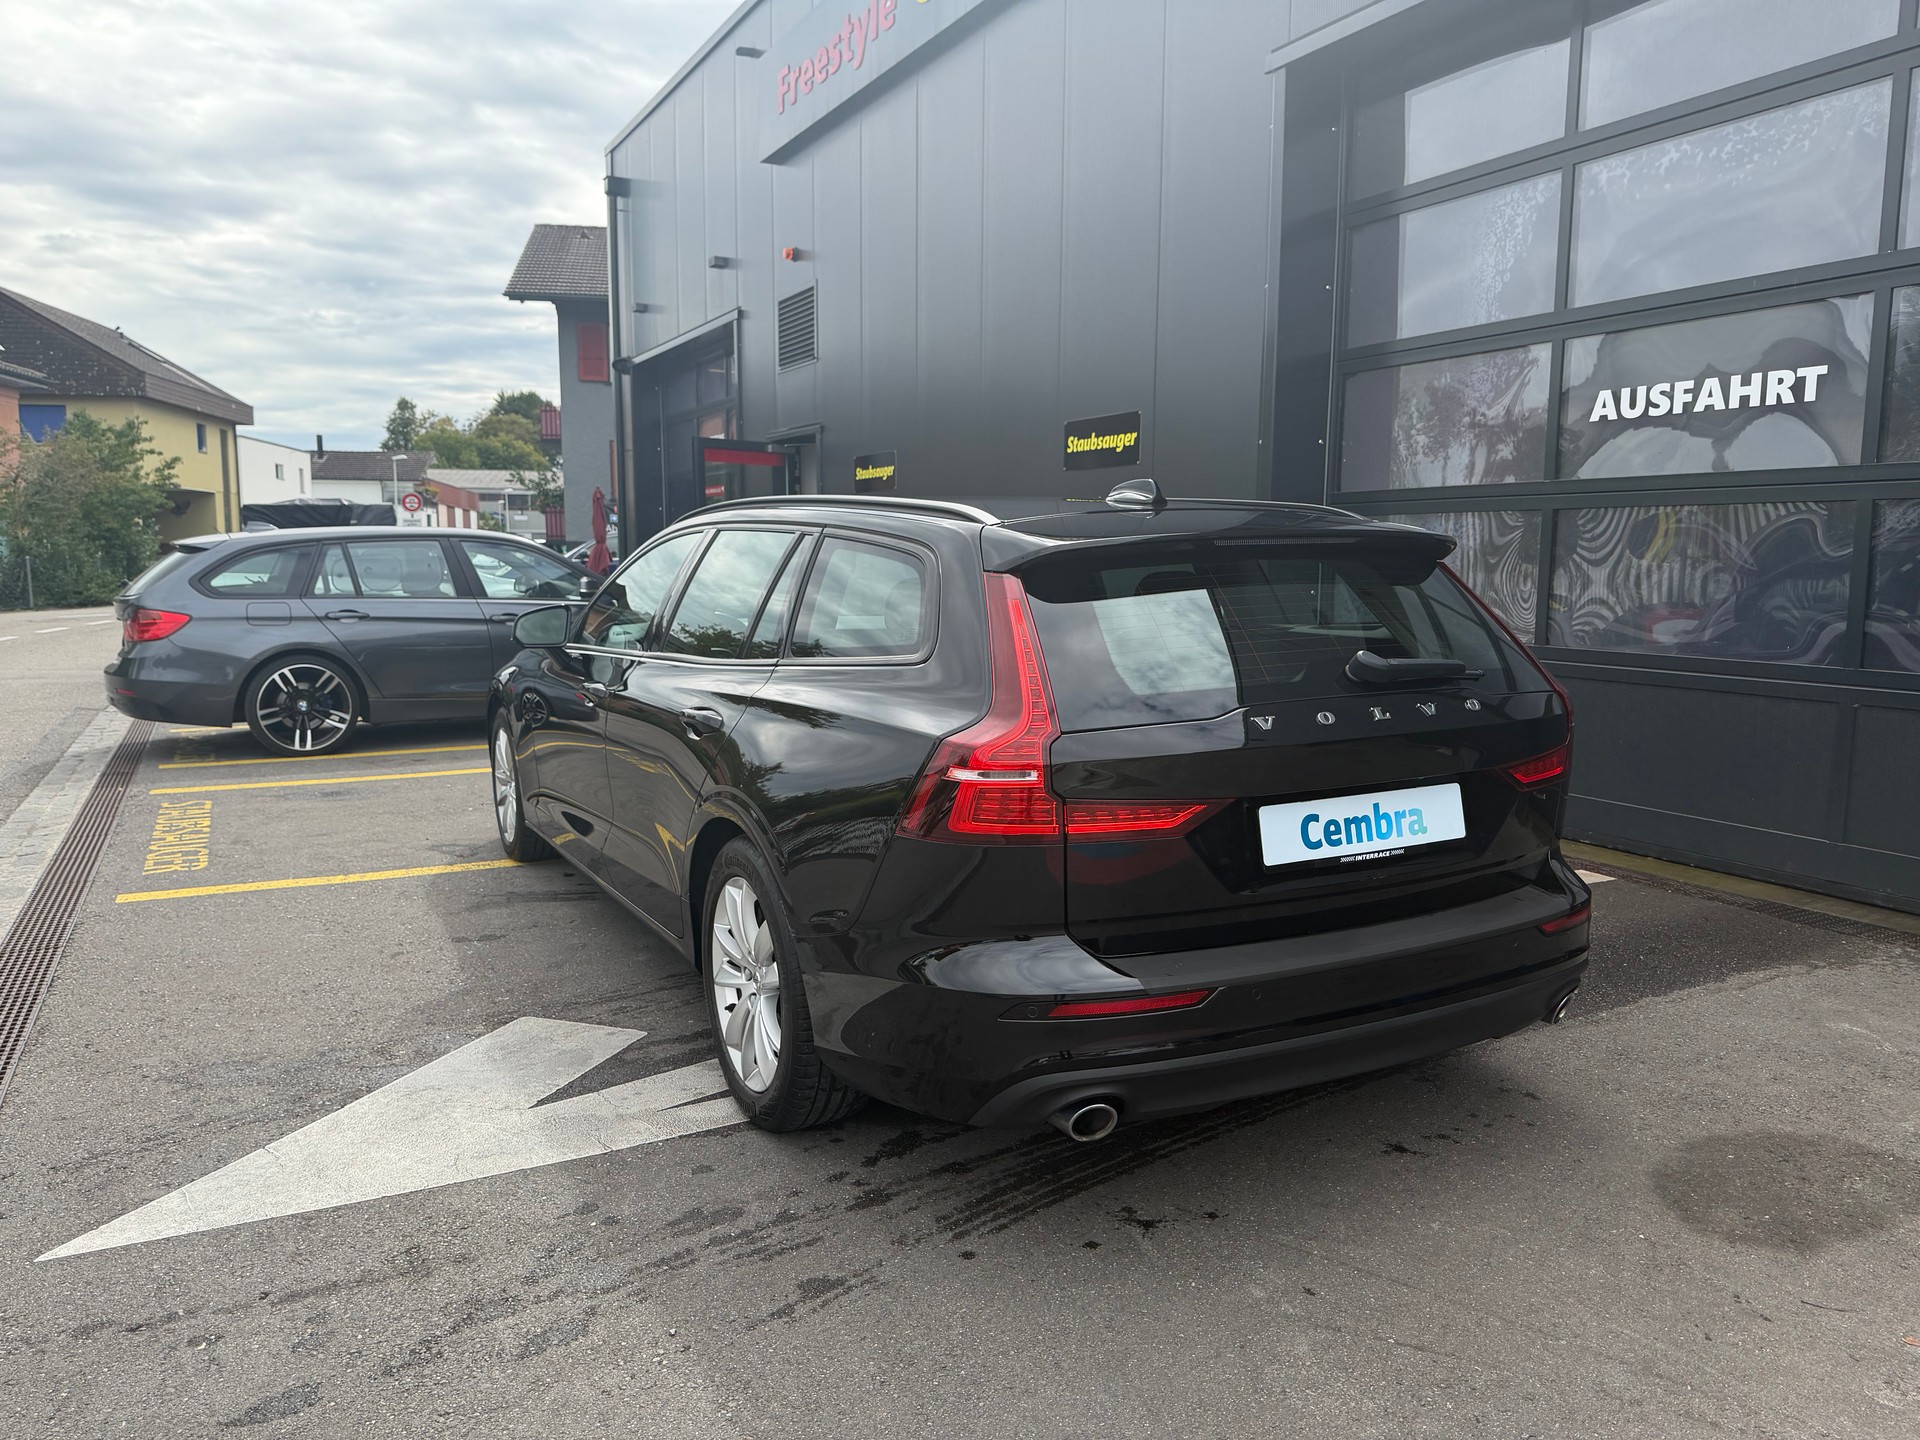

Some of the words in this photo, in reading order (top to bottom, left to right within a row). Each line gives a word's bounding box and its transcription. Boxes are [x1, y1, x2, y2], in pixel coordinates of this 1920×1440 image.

[777, 0, 897, 115] Freestyle
[1588, 364, 1829, 423] AUSFAHRT
[1066, 430, 1138, 454] Staubsauger
[855, 464, 895, 480] Staubsauger
[1250, 697, 1482, 731] VOLVO
[142, 800, 213, 875] STAUBSAUGER
[1300, 802, 1428, 851] Cembra
[1355, 850, 1391, 861] INTERRACE
